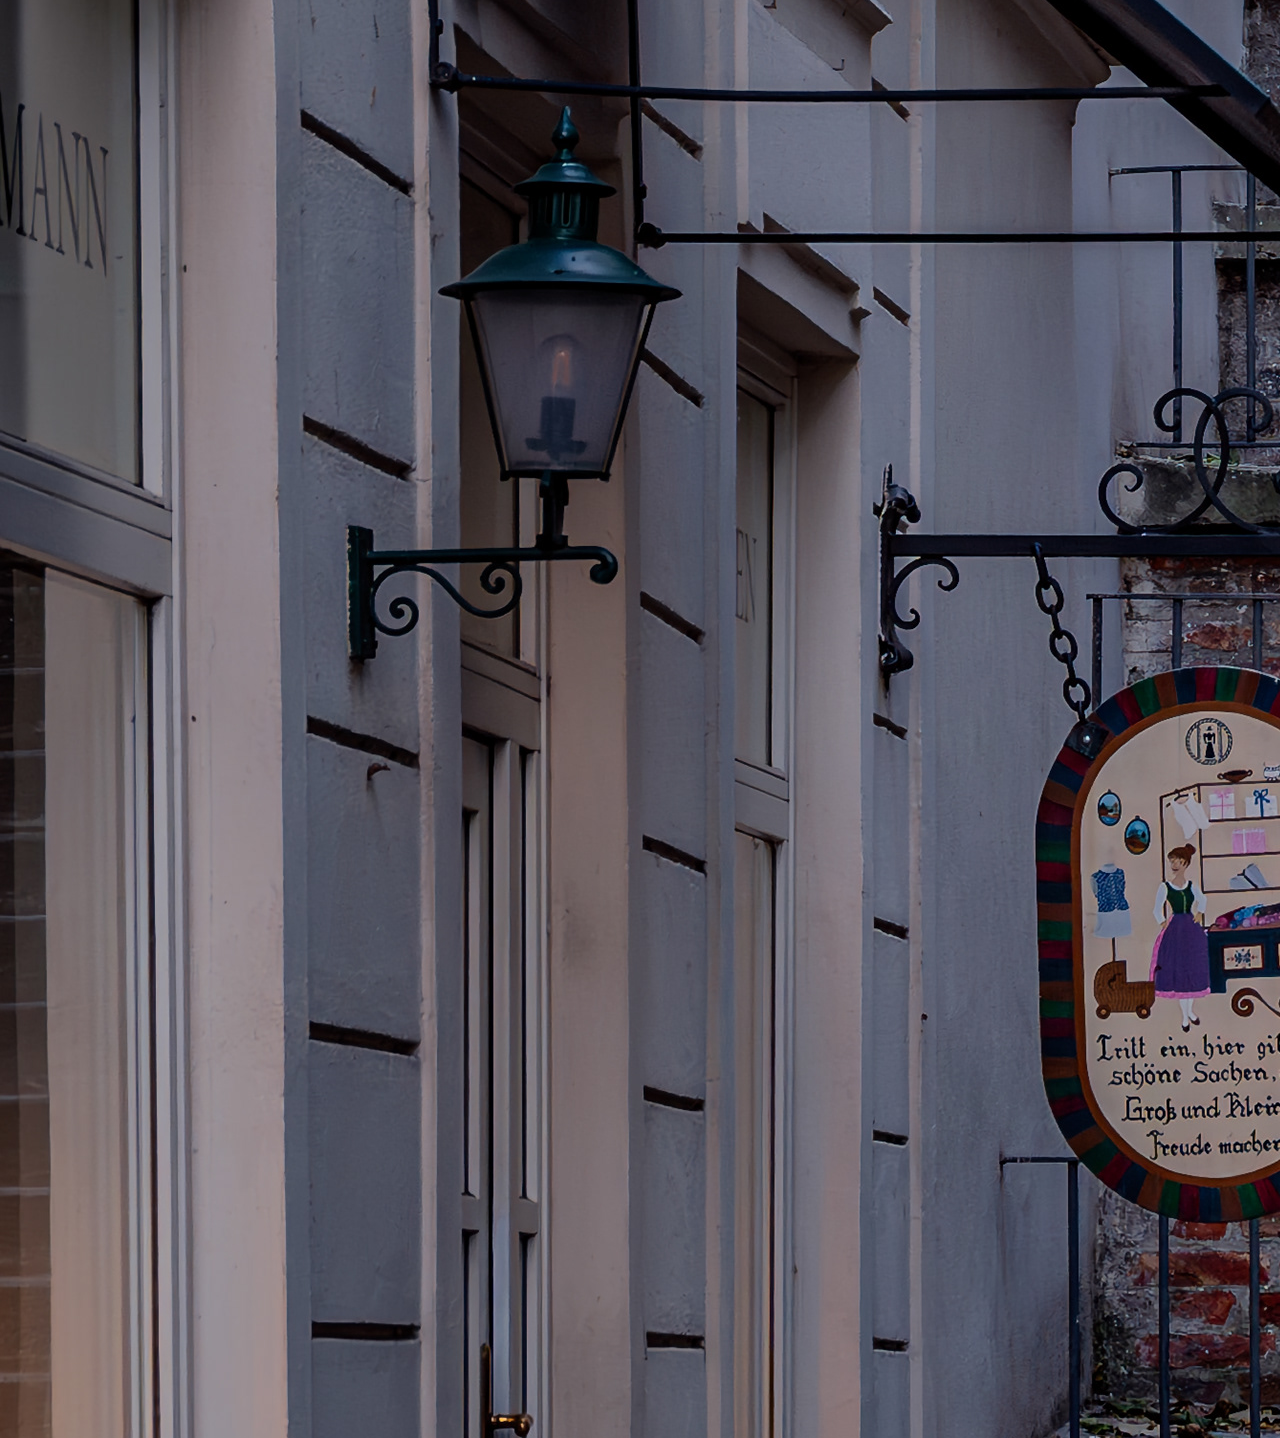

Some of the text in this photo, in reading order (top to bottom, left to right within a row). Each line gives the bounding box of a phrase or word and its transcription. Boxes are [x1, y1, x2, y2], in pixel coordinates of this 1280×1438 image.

[0, 92, 108, 278] MANN
[1096, 1033, 1146, 1062] Tritt
[1160, 1036, 1196, 1059] ein,
[1202, 1033, 1246, 1060] hier
[1108, 1062, 1182, 1090] schöne
[1190, 1060, 1276, 1086] Sachen,
[1121, 1095, 1177, 1125] Groß
[1181, 1096, 1221, 1119] und
[1146, 1129, 1212, 1161] Freude
